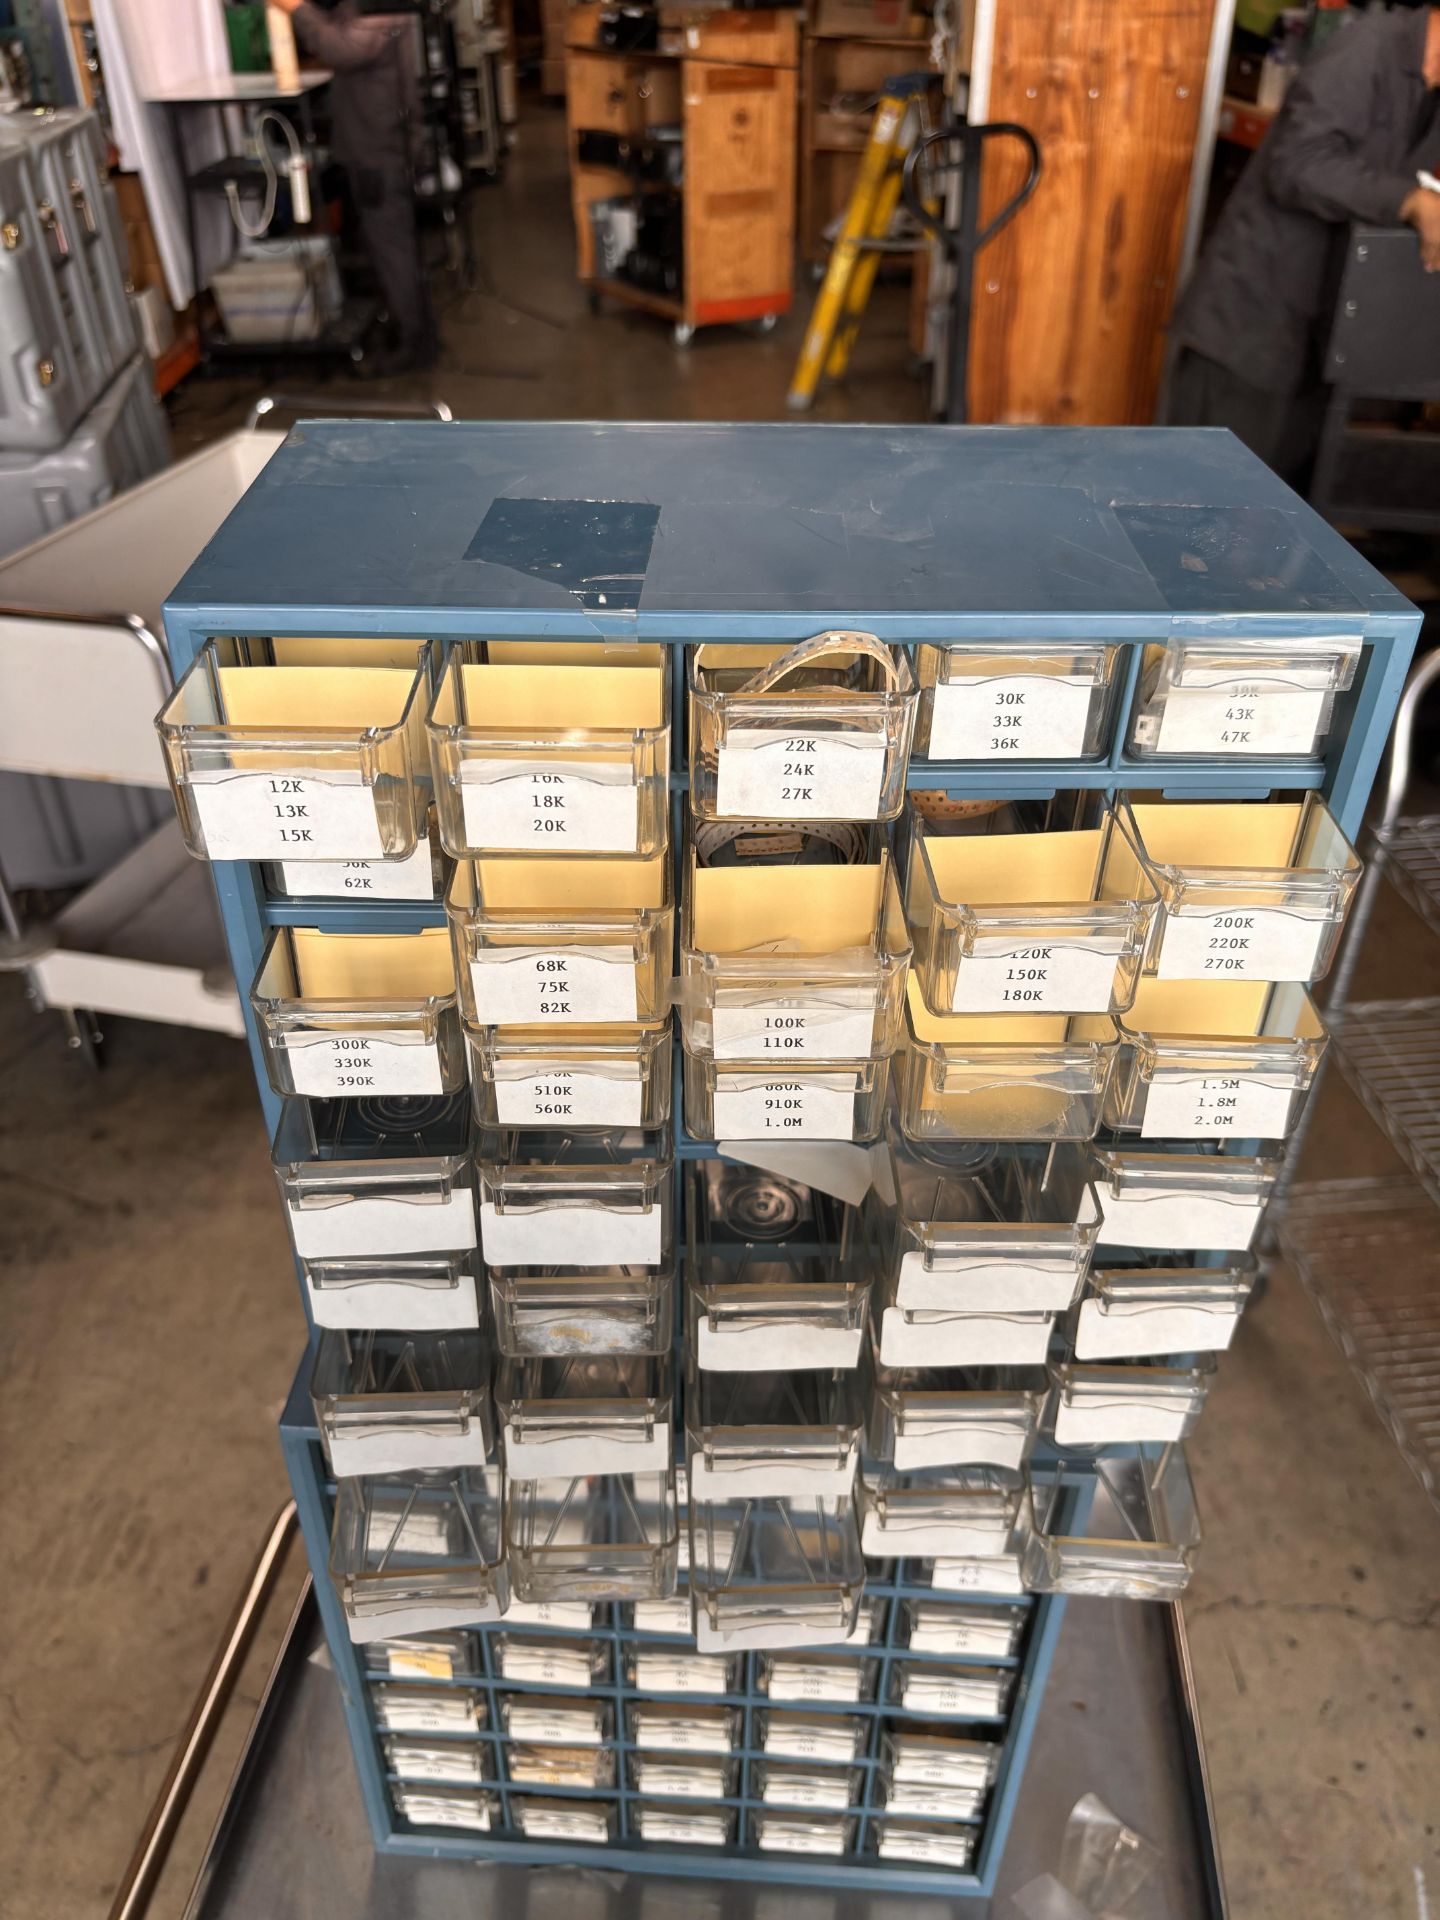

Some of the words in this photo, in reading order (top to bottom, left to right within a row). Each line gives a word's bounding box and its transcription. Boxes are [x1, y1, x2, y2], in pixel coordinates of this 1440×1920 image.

[996, 693, 1025, 704] 30K
[1226, 709, 1254, 719] 43K
[993, 716, 1022, 727] 33K
[1221, 731, 1250, 742] 47K
[785, 740, 816, 752] 22K
[991, 738, 1019, 749] 36K
[784, 764, 814, 775] 24K
[270, 780, 306, 793] 12K
[782, 788, 812, 799] 27K
[533, 795, 565, 807] 18K
[274, 805, 309, 817] 13K
[534, 820, 566, 831] 20K
[280, 830, 313, 841] 15K
[345, 878, 373, 888] 62K
[1214, 917, 1255, 928] 200K
[1209, 938, 1250, 948] 220K
[536, 961, 567, 971] 68K
[1205, 959, 1245, 969] 270K
[1006, 969, 1047, 980] 150K
[538, 982, 570, 992] 75K
[1003, 990, 1043, 1000] 180K
[541, 1003, 572, 1013] 82K
[765, 1018, 805, 1028] 100K
[332, 1040, 370, 1050] 300K
[764, 1038, 804, 1047] 110K
[335, 1058, 373, 1067] 330K
[337, 1077, 375, 1086] 390K
[1202, 1080, 1240, 1089] 1.5M
[535, 1086, 572, 1095] 510K
[765, 1100, 803, 1109] 910K
[1198, 1098, 1236, 1107] 1.8M
[535, 1104, 572, 1114] 560K
[765, 1118, 802, 1127] 1.0M
[1194, 1116, 1233, 1125] 2.0M
